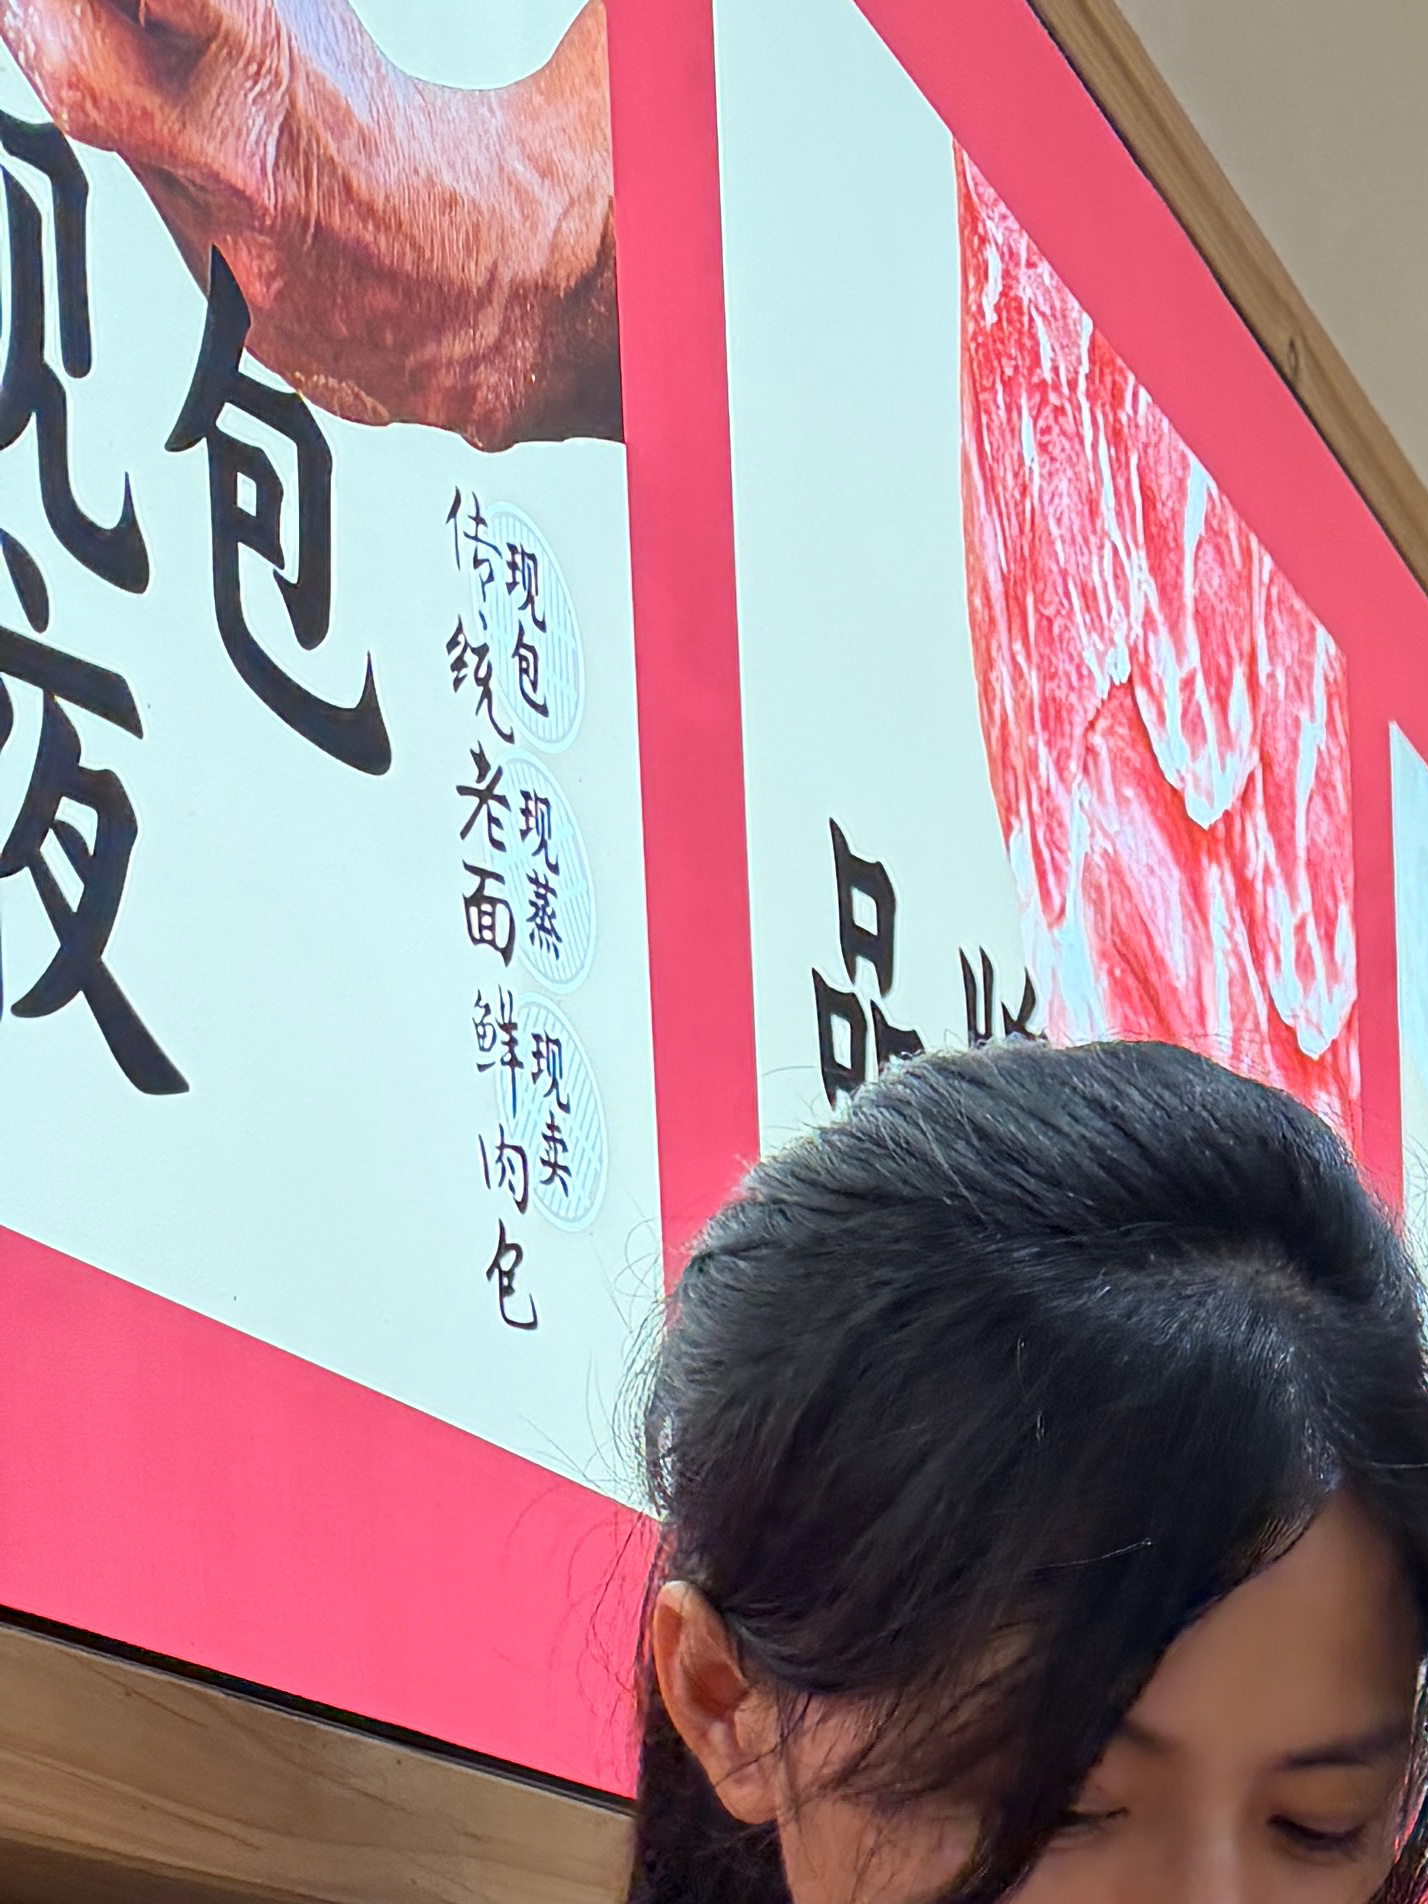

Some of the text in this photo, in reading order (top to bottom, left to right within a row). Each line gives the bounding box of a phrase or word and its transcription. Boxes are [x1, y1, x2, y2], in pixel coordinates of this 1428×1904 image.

[445, 486, 538, 1330] 传统老面鲜肉包
[505, 542, 573, 1198] 现包 现蒸 现卖
